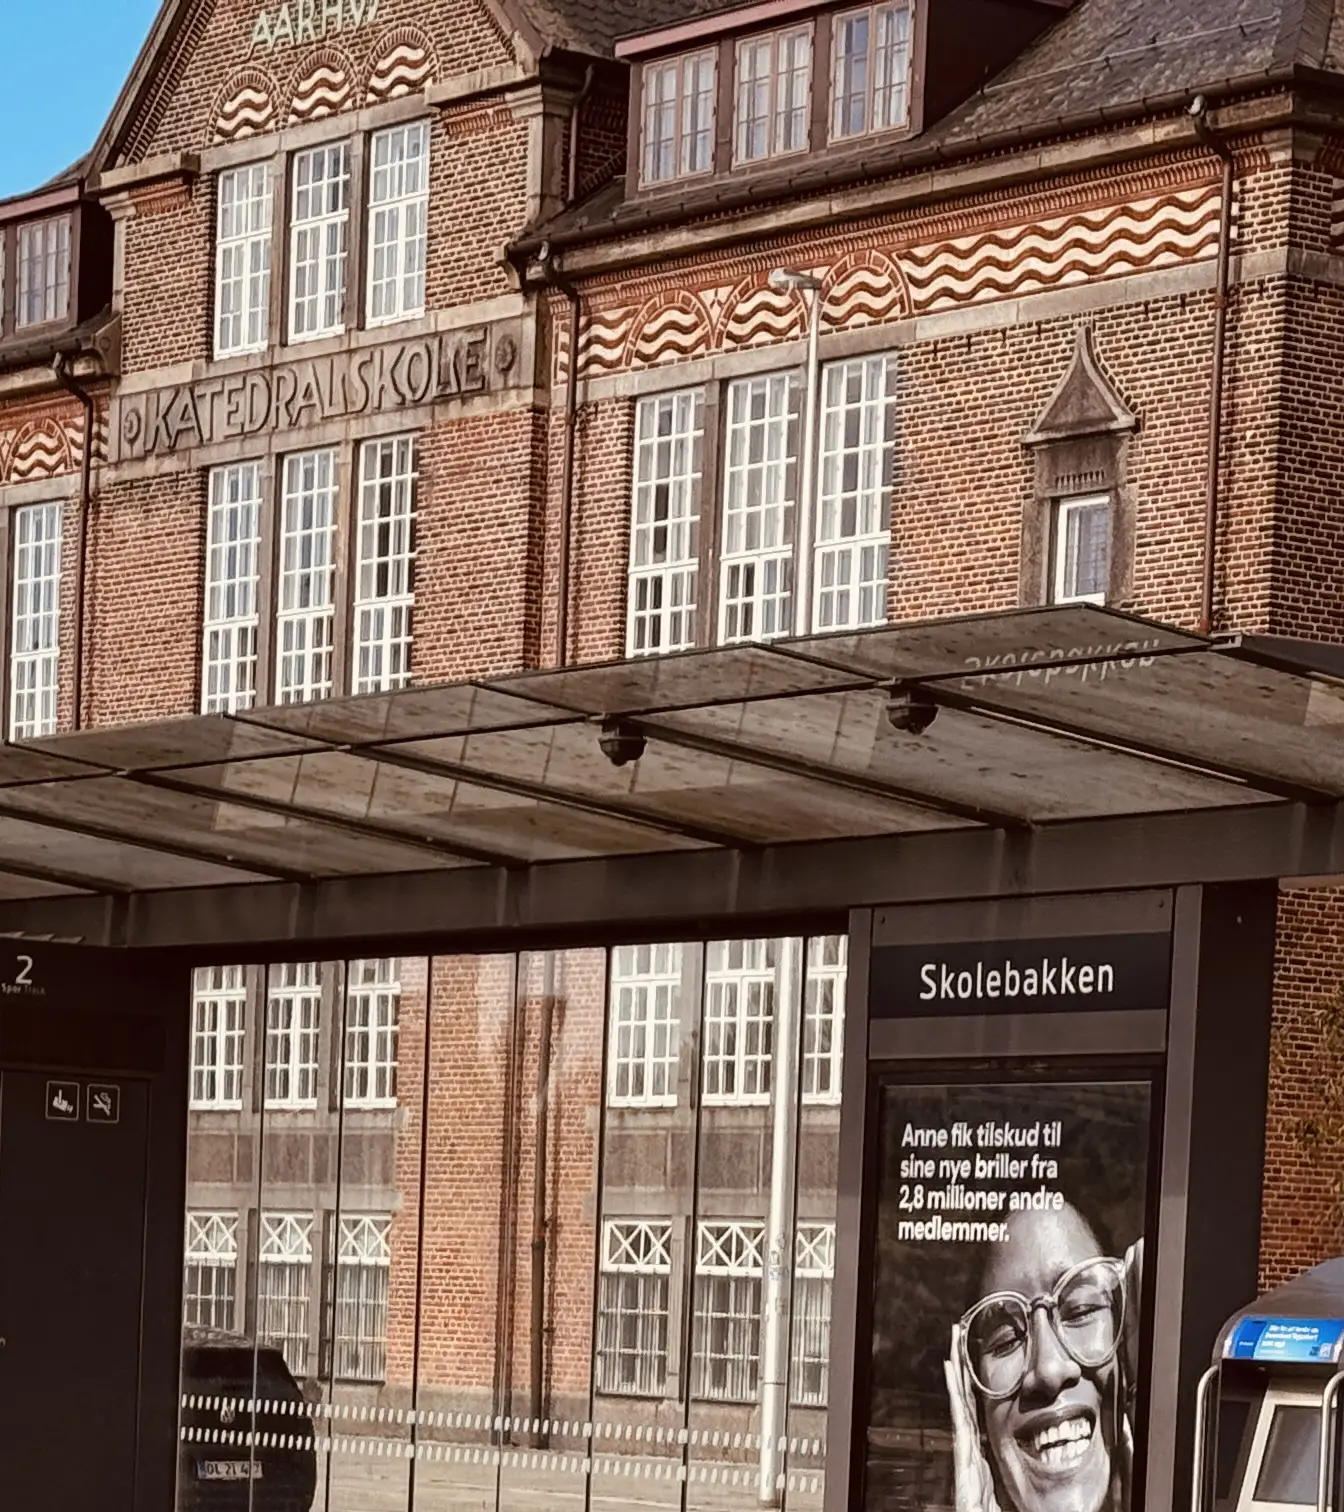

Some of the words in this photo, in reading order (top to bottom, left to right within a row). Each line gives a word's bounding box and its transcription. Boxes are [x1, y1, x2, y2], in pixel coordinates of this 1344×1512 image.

[144, 327, 488, 451] KATEDRALSKOLE
[15, 955, 33, 985] 2
[919, 957, 1115, 1001] Skolebakken
[901, 1122, 949, 1147] Anne
[951, 1121, 973, 1147] fik
[976, 1121, 1040, 1147] tilskud
[1043, 1121, 1062, 1147] til
[900, 1152, 936, 1178] sine
[939, 1158, 972, 1185] nye
[974, 1152, 1029, 1179] briller
[1031, 1152, 1058, 1179] fra
[898, 1183, 925, 1213] 2,8
[926, 1183, 1007, 1210] millioner
[1008, 1184, 1065, 1211] andre
[898, 1214, 1011, 1242] medlemmer.
